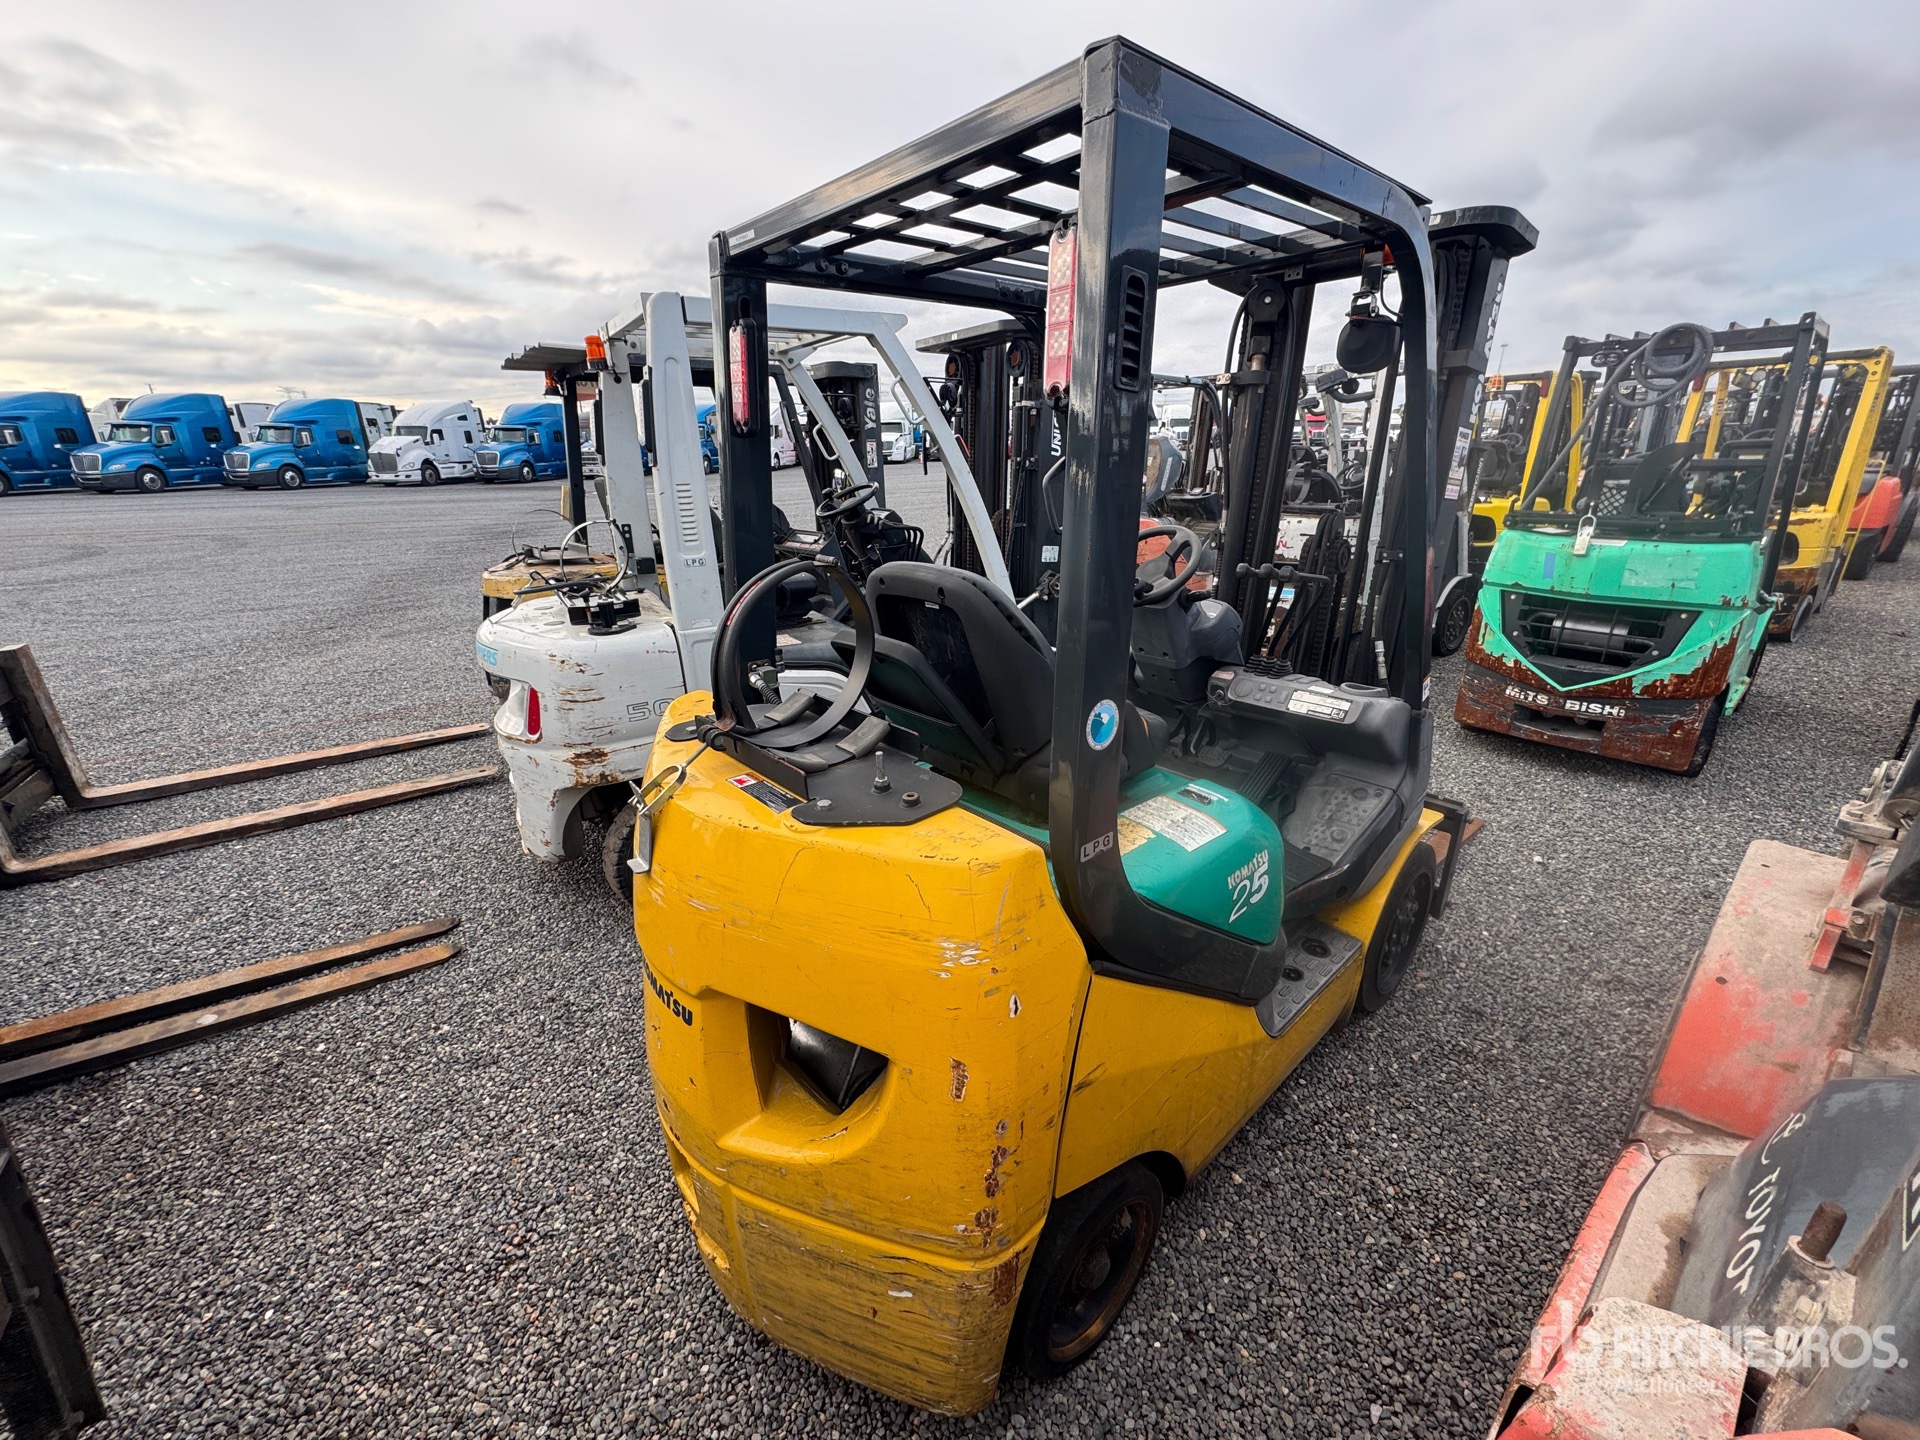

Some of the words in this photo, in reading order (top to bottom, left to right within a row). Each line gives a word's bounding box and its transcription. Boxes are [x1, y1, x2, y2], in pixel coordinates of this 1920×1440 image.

[863, 388, 877, 431] Yale
[684, 558, 706, 567] LPG
[1082, 834, 1111, 859] LPG
[1227, 849, 1269, 890] KOMATSU
[1228, 861, 1269, 924] 25
